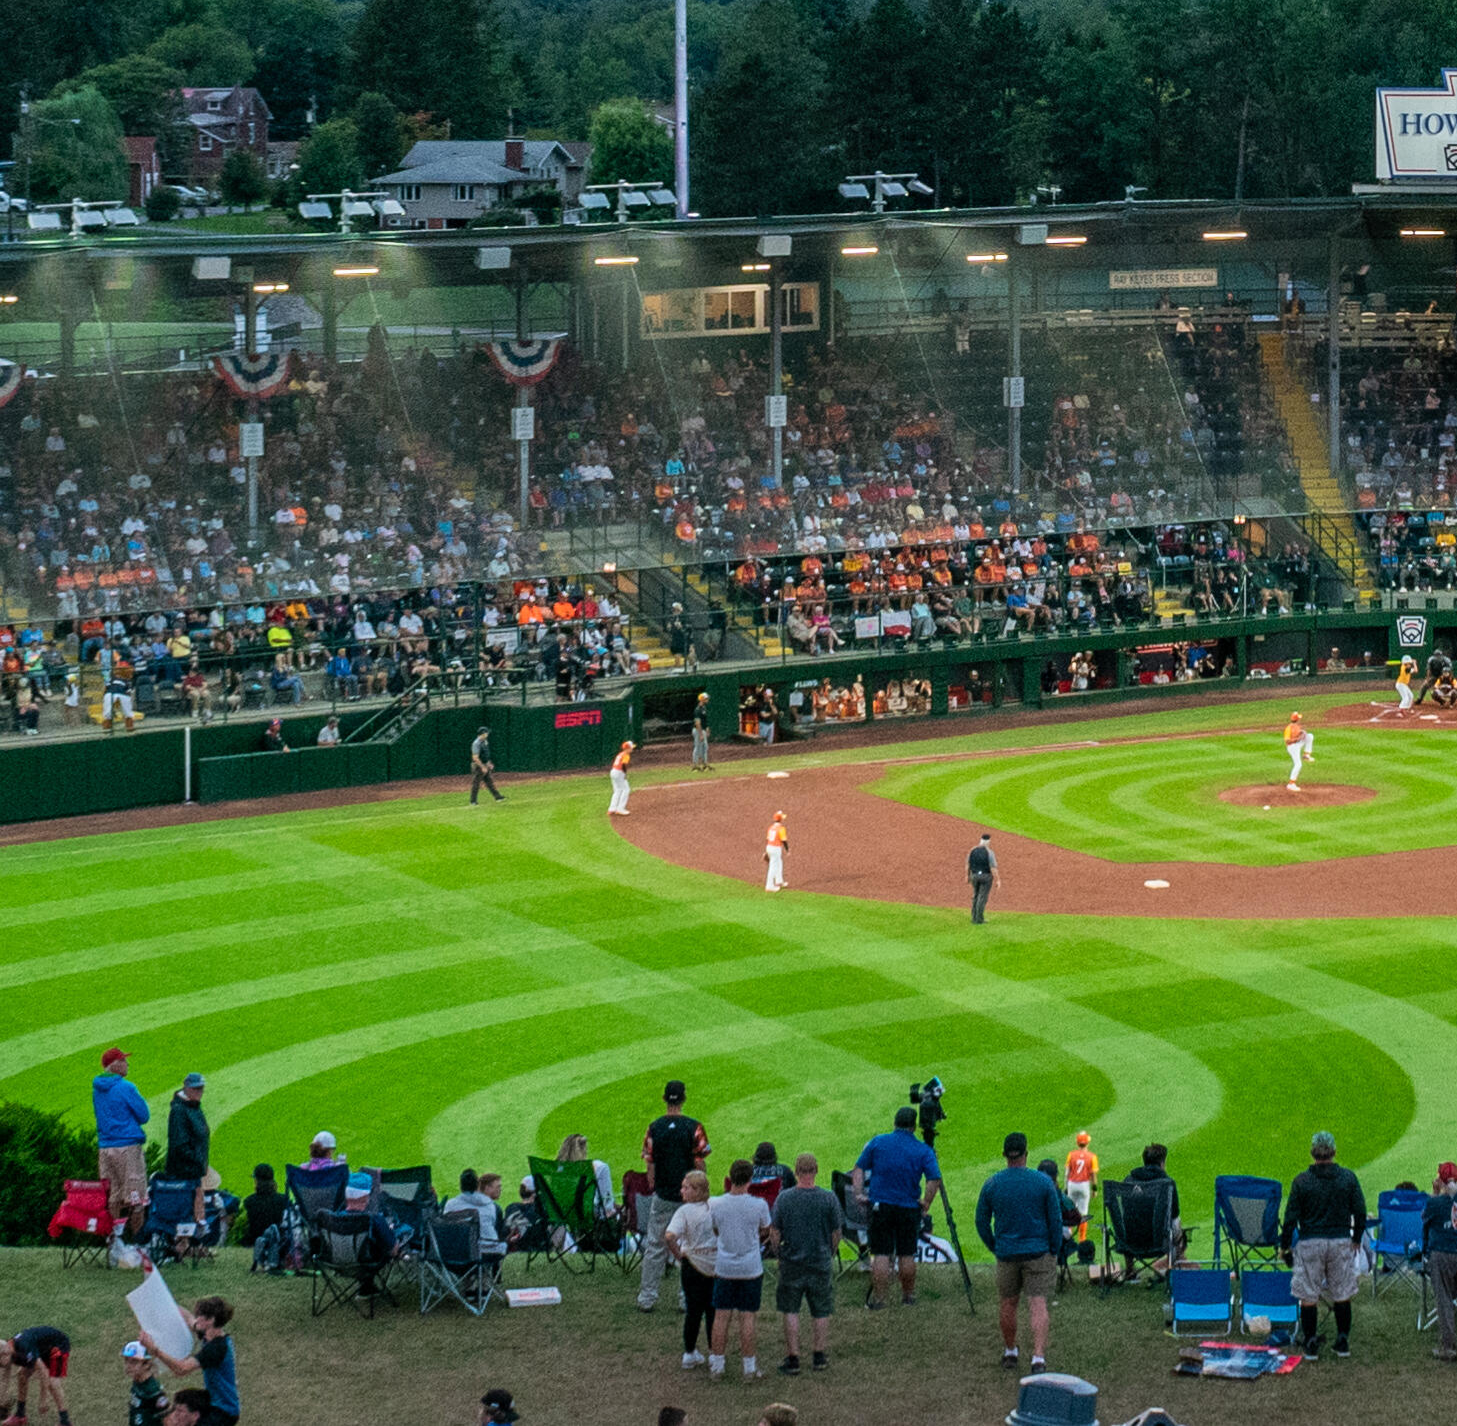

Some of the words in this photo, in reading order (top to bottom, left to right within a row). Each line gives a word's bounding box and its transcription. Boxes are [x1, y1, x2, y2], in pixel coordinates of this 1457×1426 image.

[1155, 274, 1180, 284] PRESS
[1182, 272, 1214, 283] SECTION
[555, 710, 602, 729] ESPN
[1076, 1159, 1085, 1174] 7
